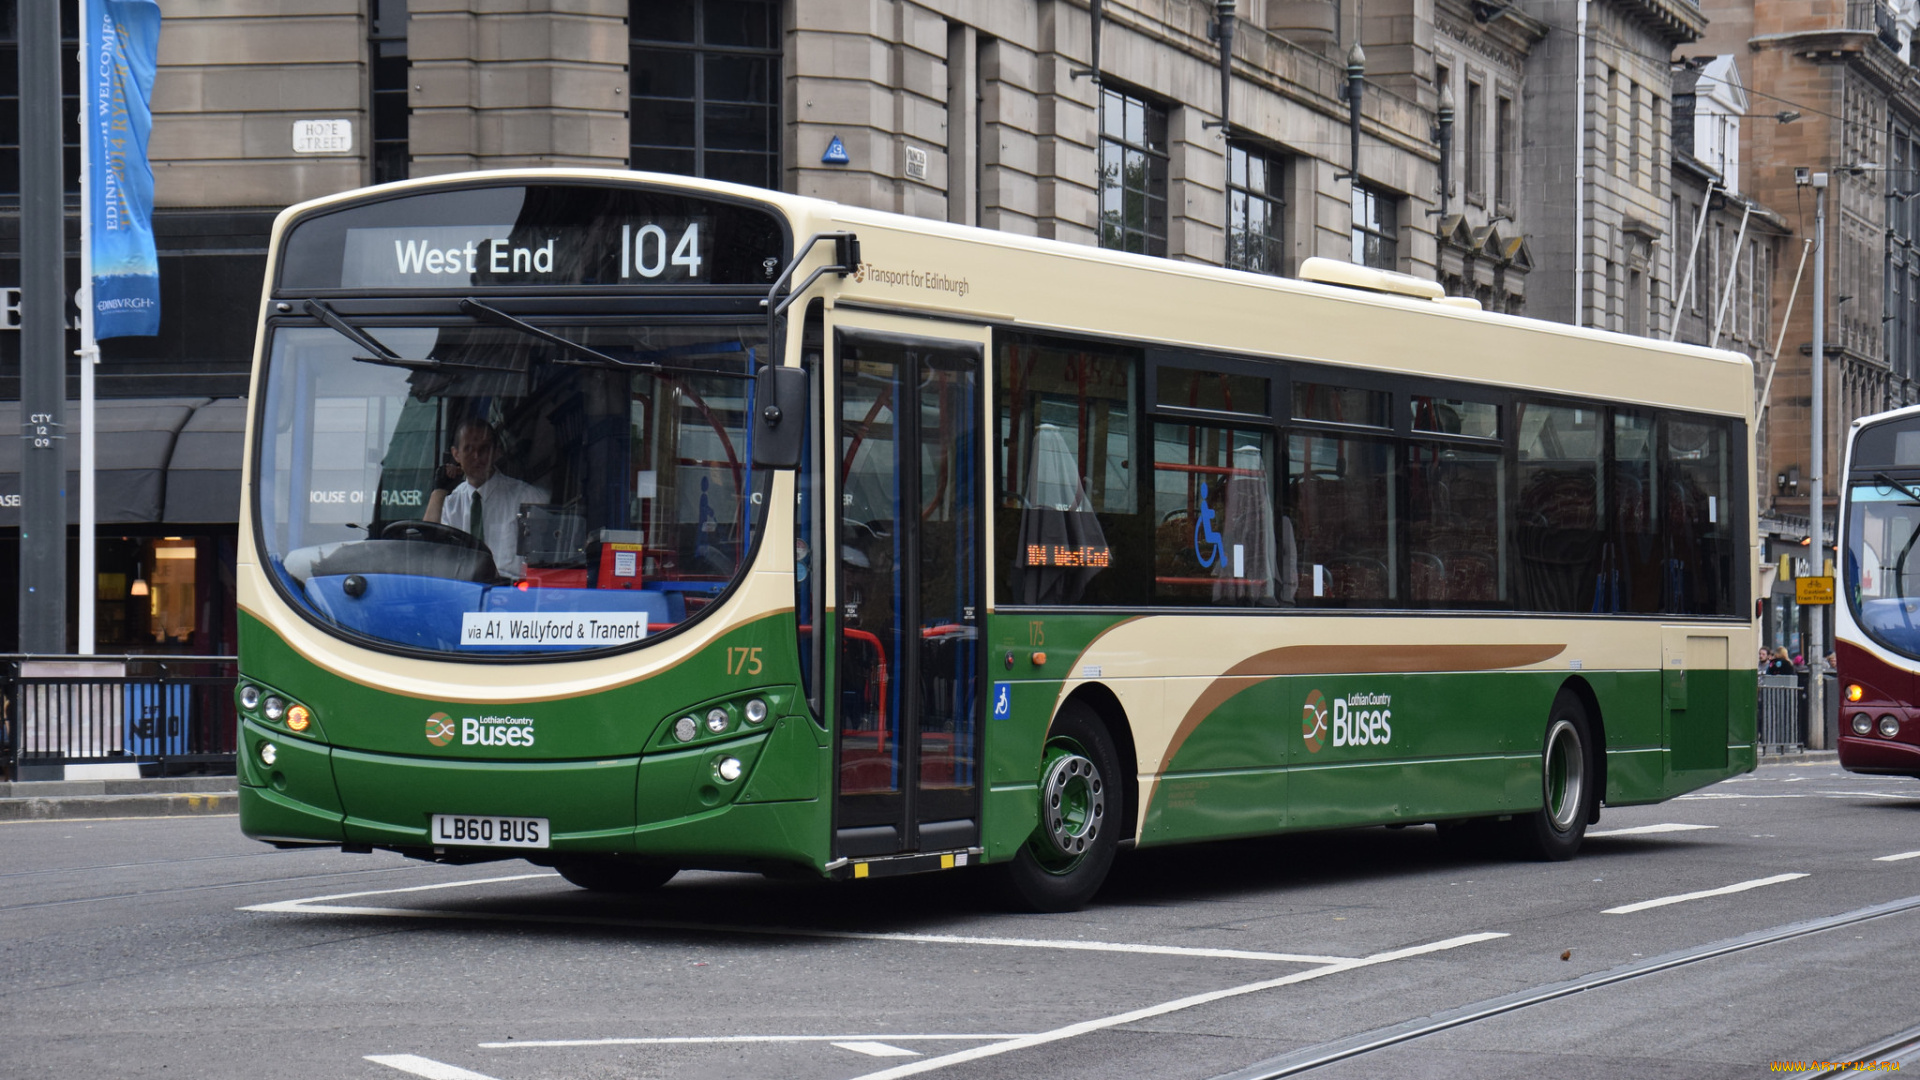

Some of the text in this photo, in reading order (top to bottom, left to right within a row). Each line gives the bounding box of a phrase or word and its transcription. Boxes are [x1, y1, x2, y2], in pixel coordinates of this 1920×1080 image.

[395, 222, 702, 279] West End 104
[866, 263, 970, 297] Transport for Edinburgh
[31, 414, 52, 423] CTY
[37, 426, 47, 435] 12
[35, 438, 50, 447] 09
[1028, 545, 1109, 567] 104 West End
[468, 620, 640, 643] via A1, Wallyford & Tranent
[1029, 620, 1045, 646] 175
[727, 647, 762, 675] 175
[1348, 692, 1391, 707] Lothian Country
[461, 718, 534, 746] Buses
[480, 715, 533, 726] Lothian Country
[1332, 698, 1391, 747] Buses
[440, 818, 539, 842] LB60 BUS
